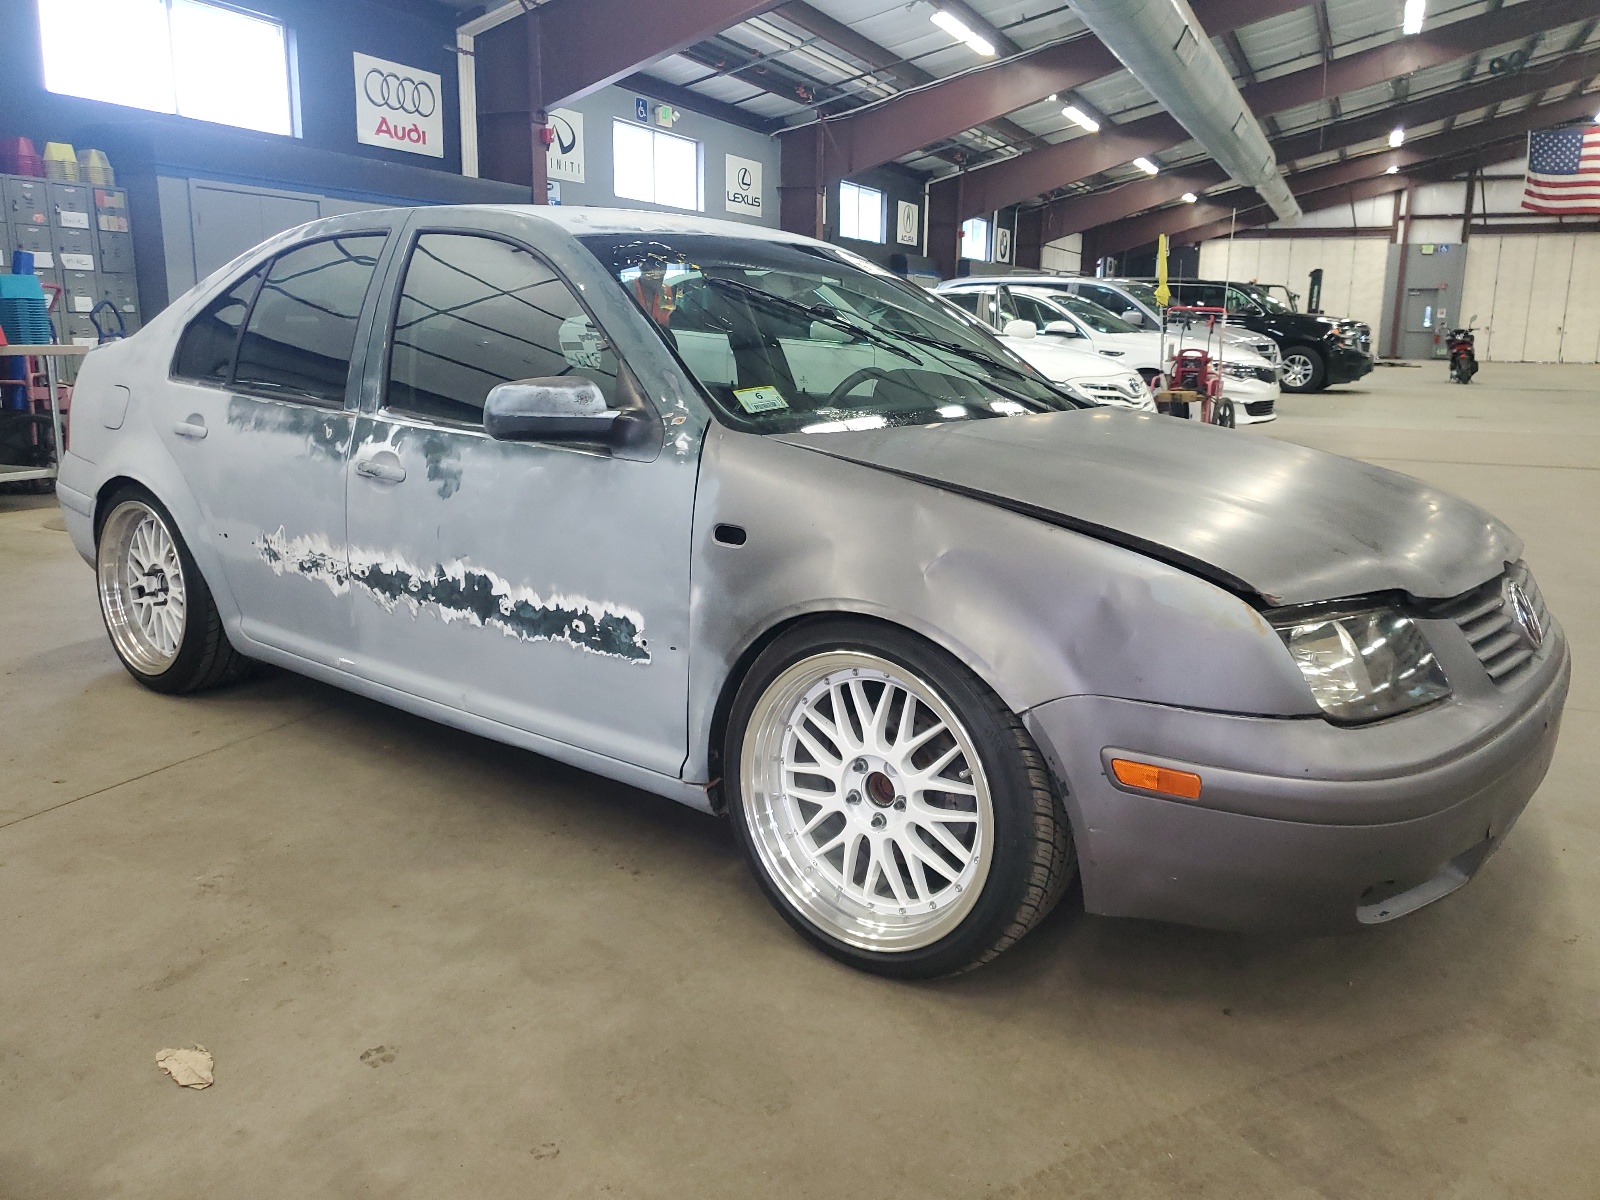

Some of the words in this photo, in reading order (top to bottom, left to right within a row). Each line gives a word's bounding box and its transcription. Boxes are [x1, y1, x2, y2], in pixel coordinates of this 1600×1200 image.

[374, 116, 427, 145] Audi
[550, 158, 581, 174] INITI
[727, 191, 760, 207] LEXUS
[901, 234, 914, 243] ACURA
[755, 392, 763, 400] 6
